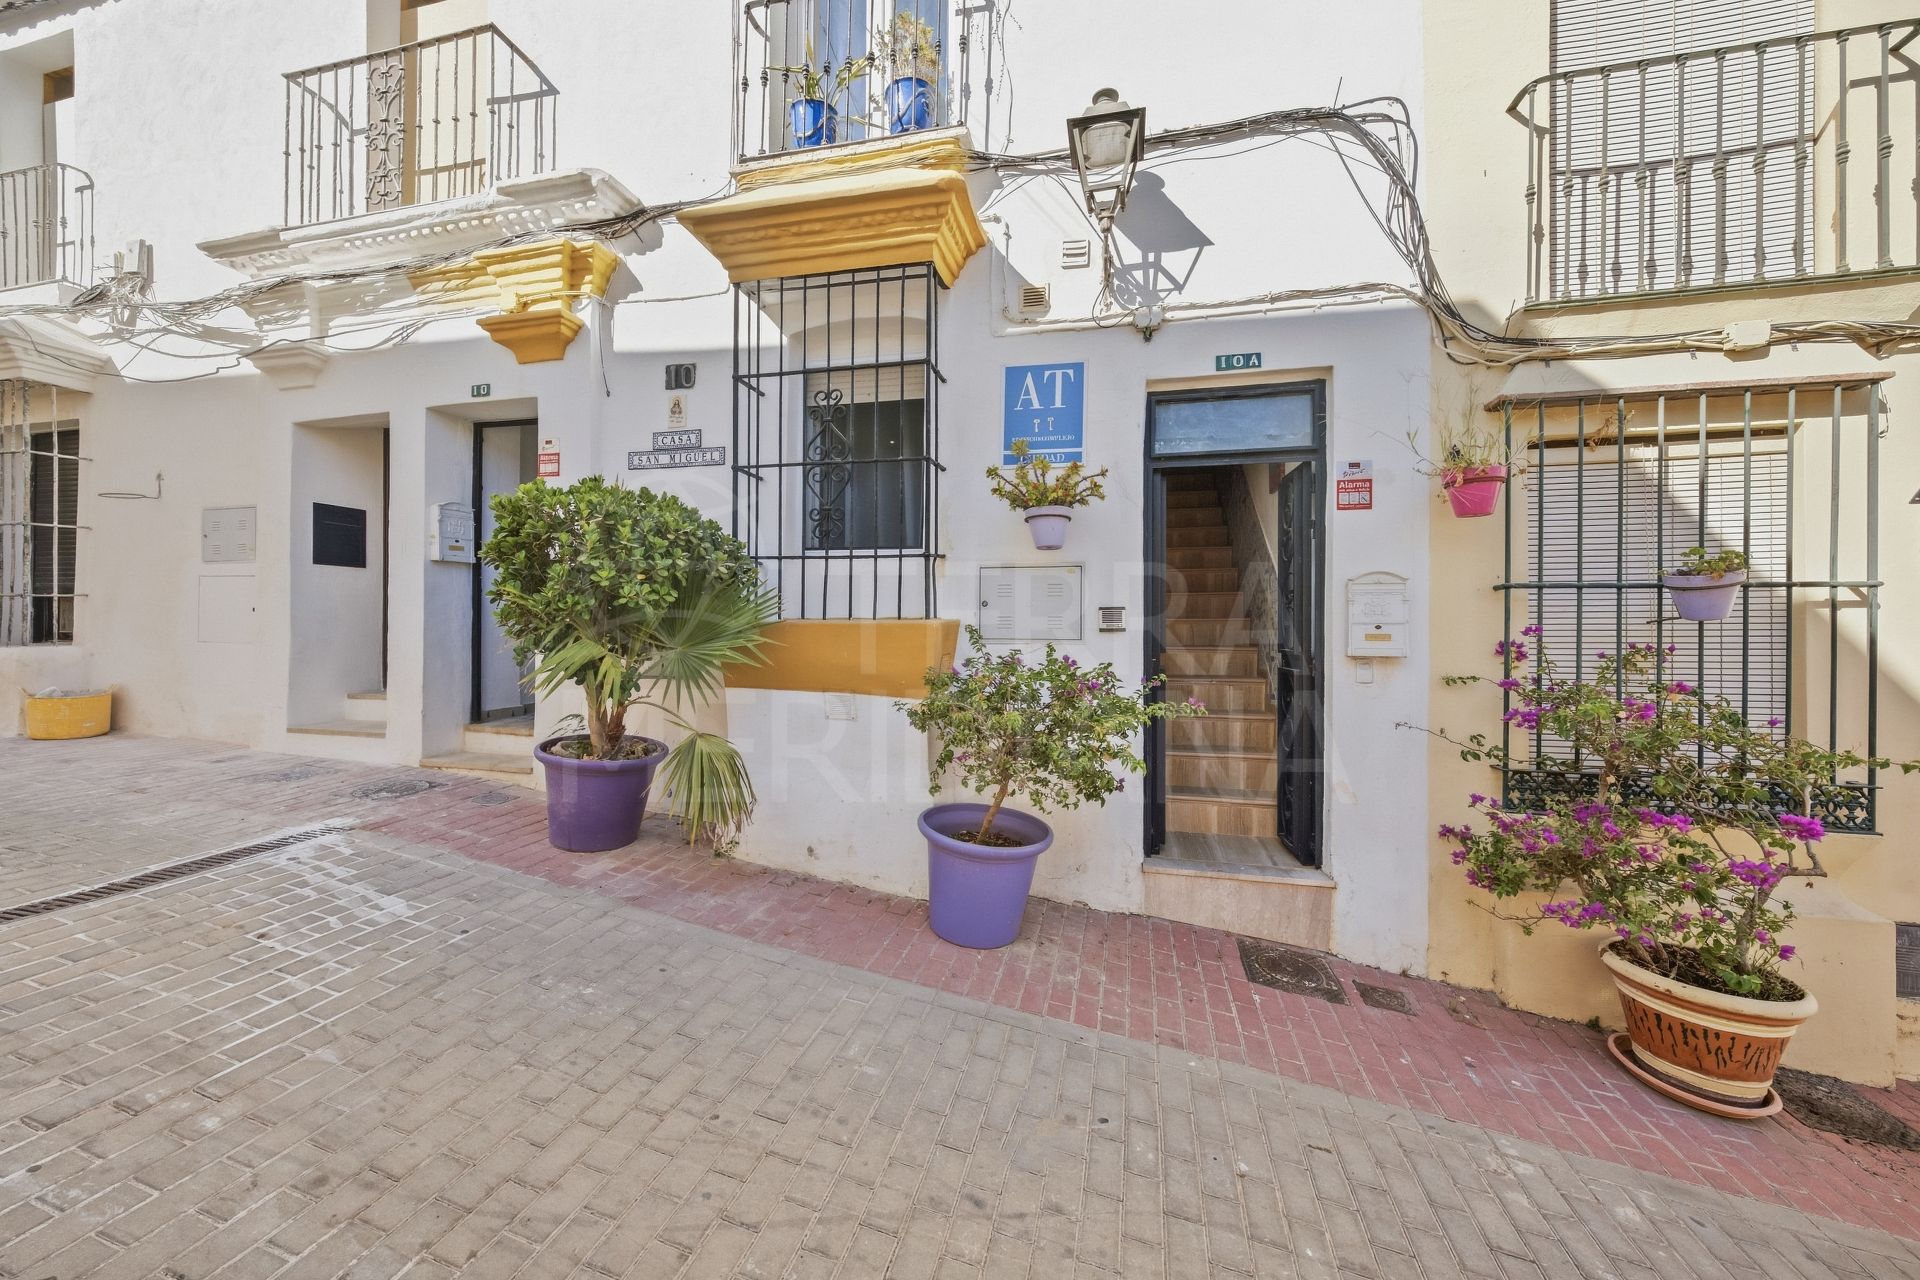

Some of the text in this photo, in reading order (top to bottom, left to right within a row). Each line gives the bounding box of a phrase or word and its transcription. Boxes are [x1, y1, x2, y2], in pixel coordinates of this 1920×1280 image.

[1220, 354, 1259, 368] 10A
[669, 364, 695, 388] 10
[473, 385, 488, 395] 10
[1013, 369, 1074, 410] AT
[661, 435, 693, 446] CASA
[637, 451, 717, 465] SAN MIGUEL
[1339, 481, 1370, 489] Alarma
